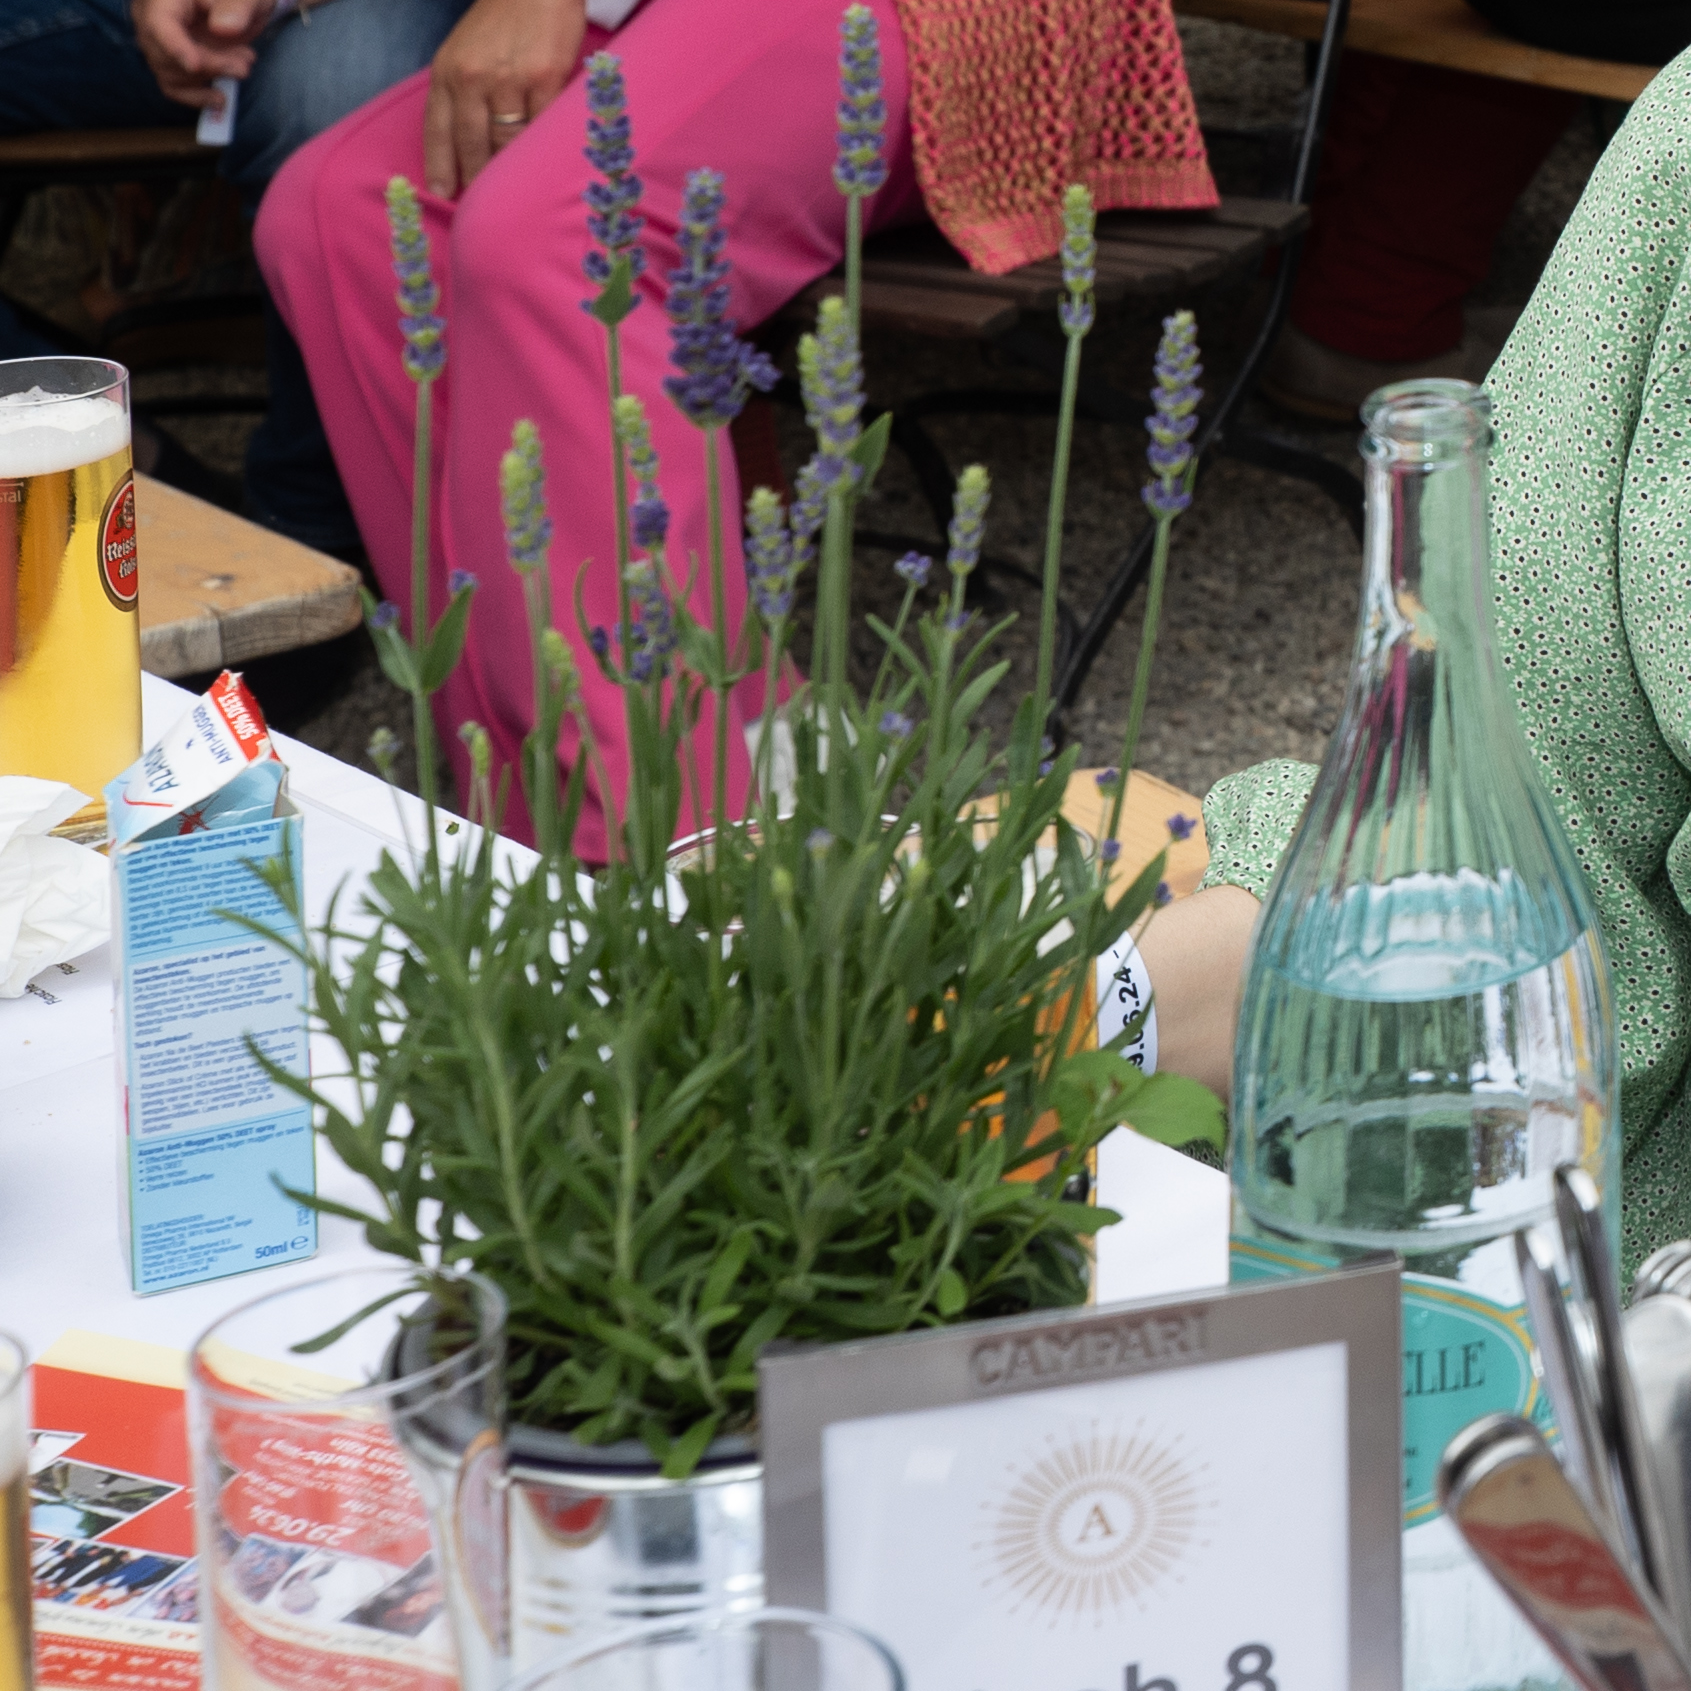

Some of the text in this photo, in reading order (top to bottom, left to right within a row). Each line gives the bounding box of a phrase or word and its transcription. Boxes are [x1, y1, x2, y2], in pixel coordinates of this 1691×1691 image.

[166, 1135, 214, 1151] Anti-Muggen
[255, 1240, 287, 1259] 50ml
[969, 1308, 1211, 1392] CAMPARI
[1074, 1503, 1118, 1546] A
